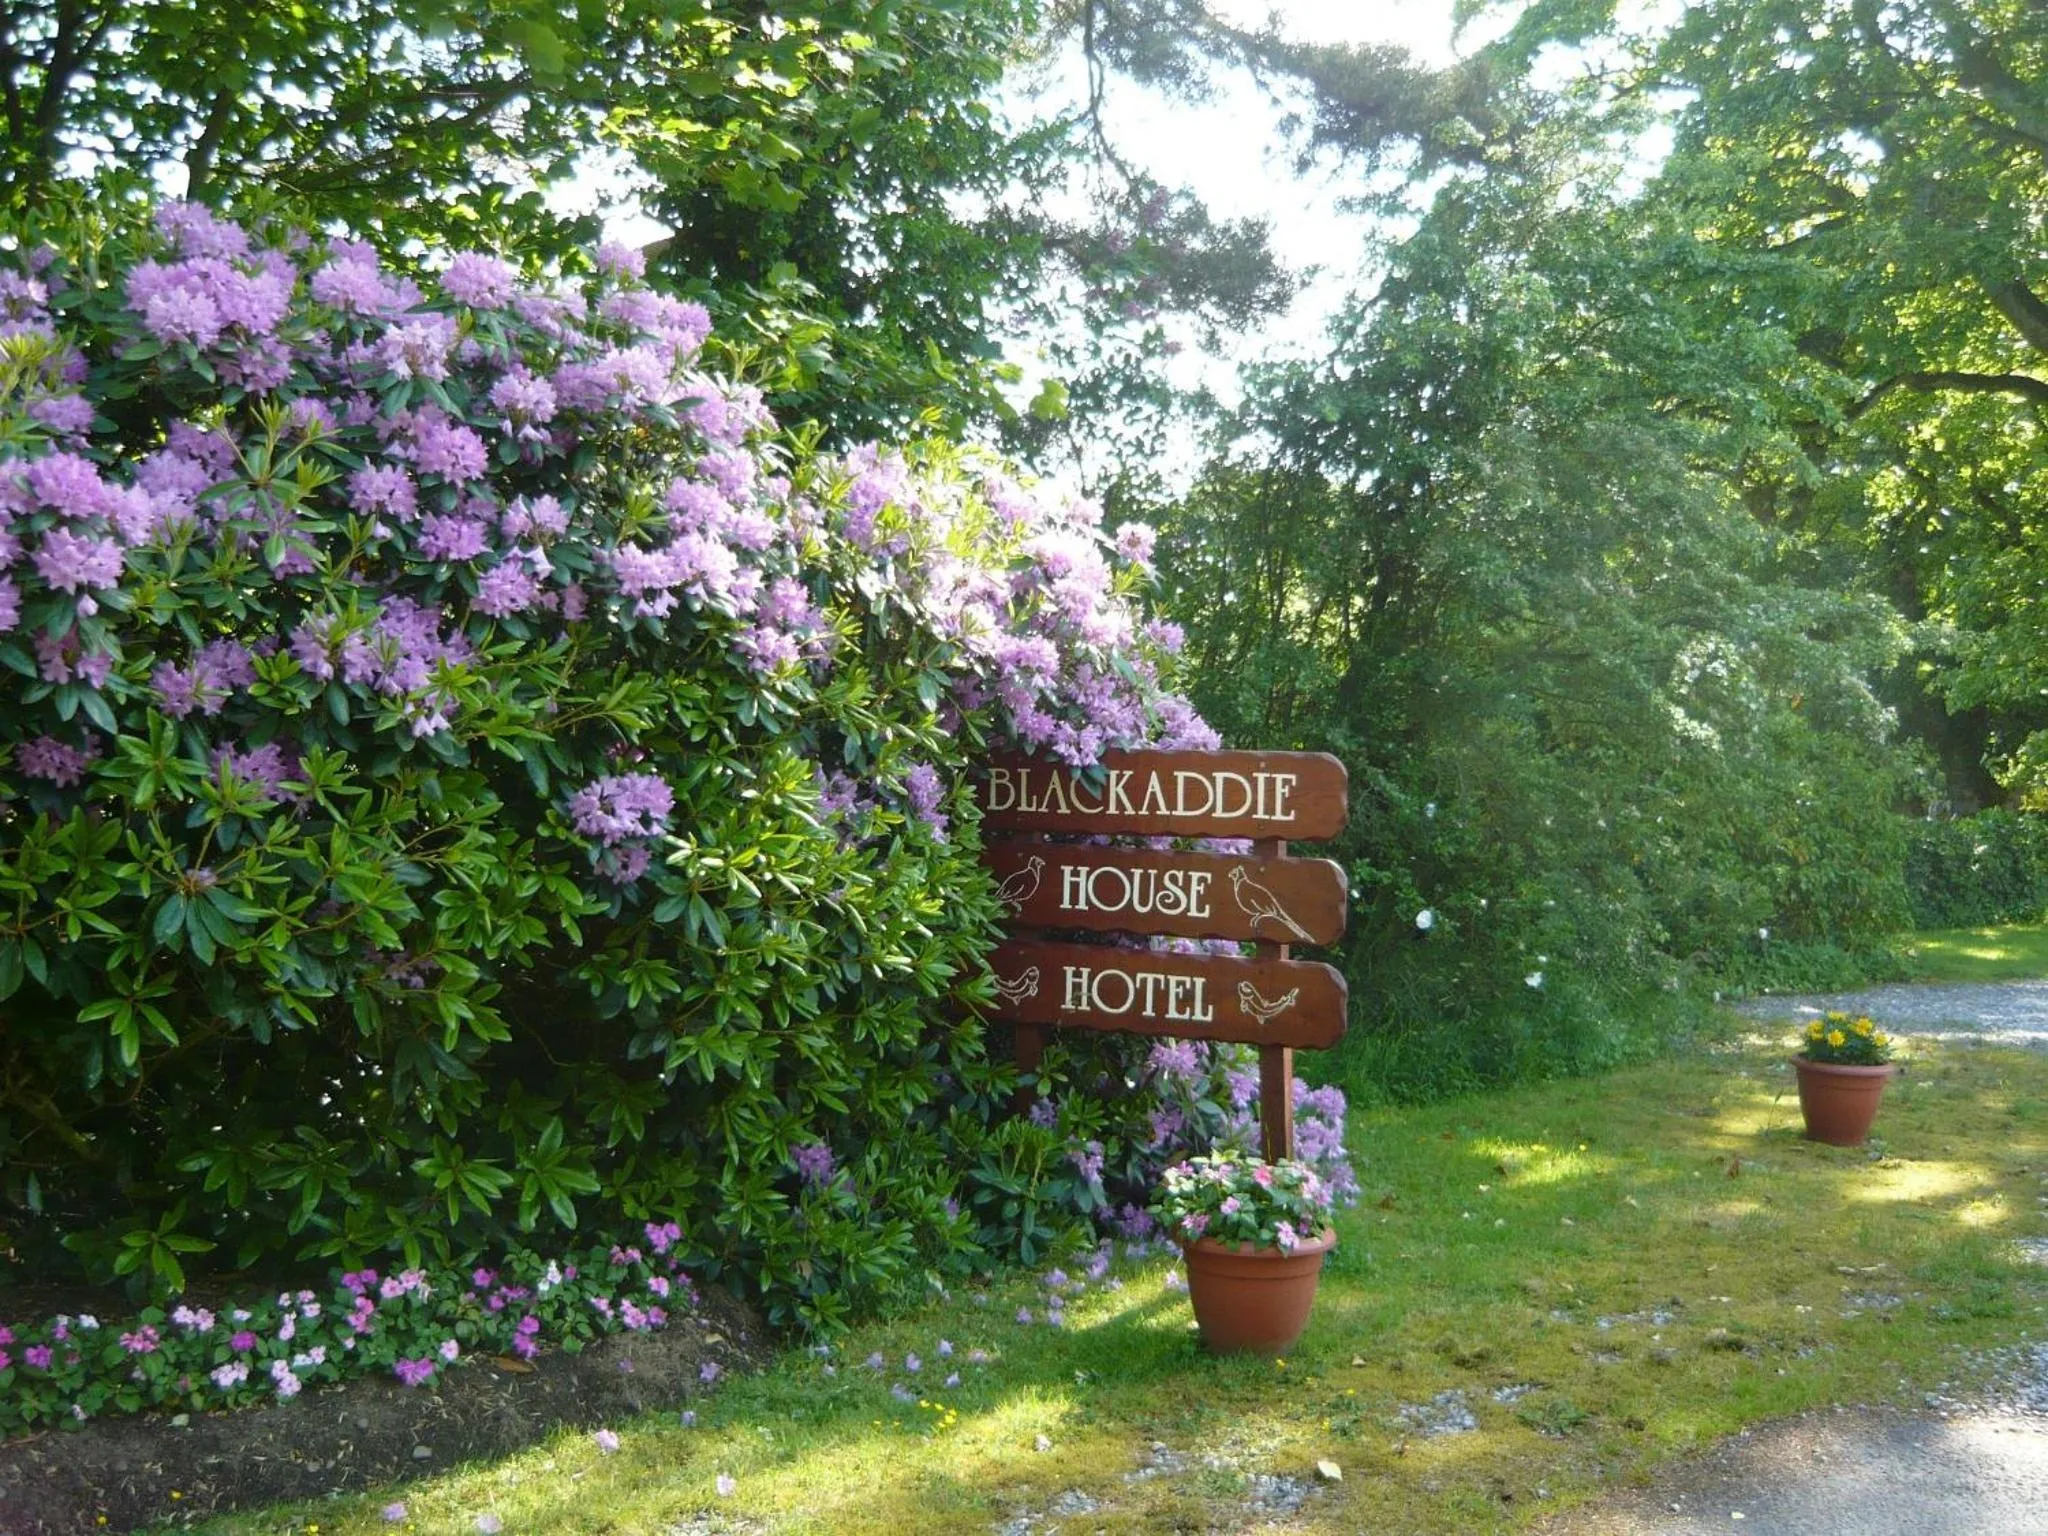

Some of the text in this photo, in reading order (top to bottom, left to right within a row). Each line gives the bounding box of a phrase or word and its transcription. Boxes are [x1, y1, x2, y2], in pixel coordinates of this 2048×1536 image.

[986, 767, 1297, 821] BLACKADDIE
[1059, 865, 1212, 918] HOUSE
[1060, 966, 1213, 1022] HOTEL
